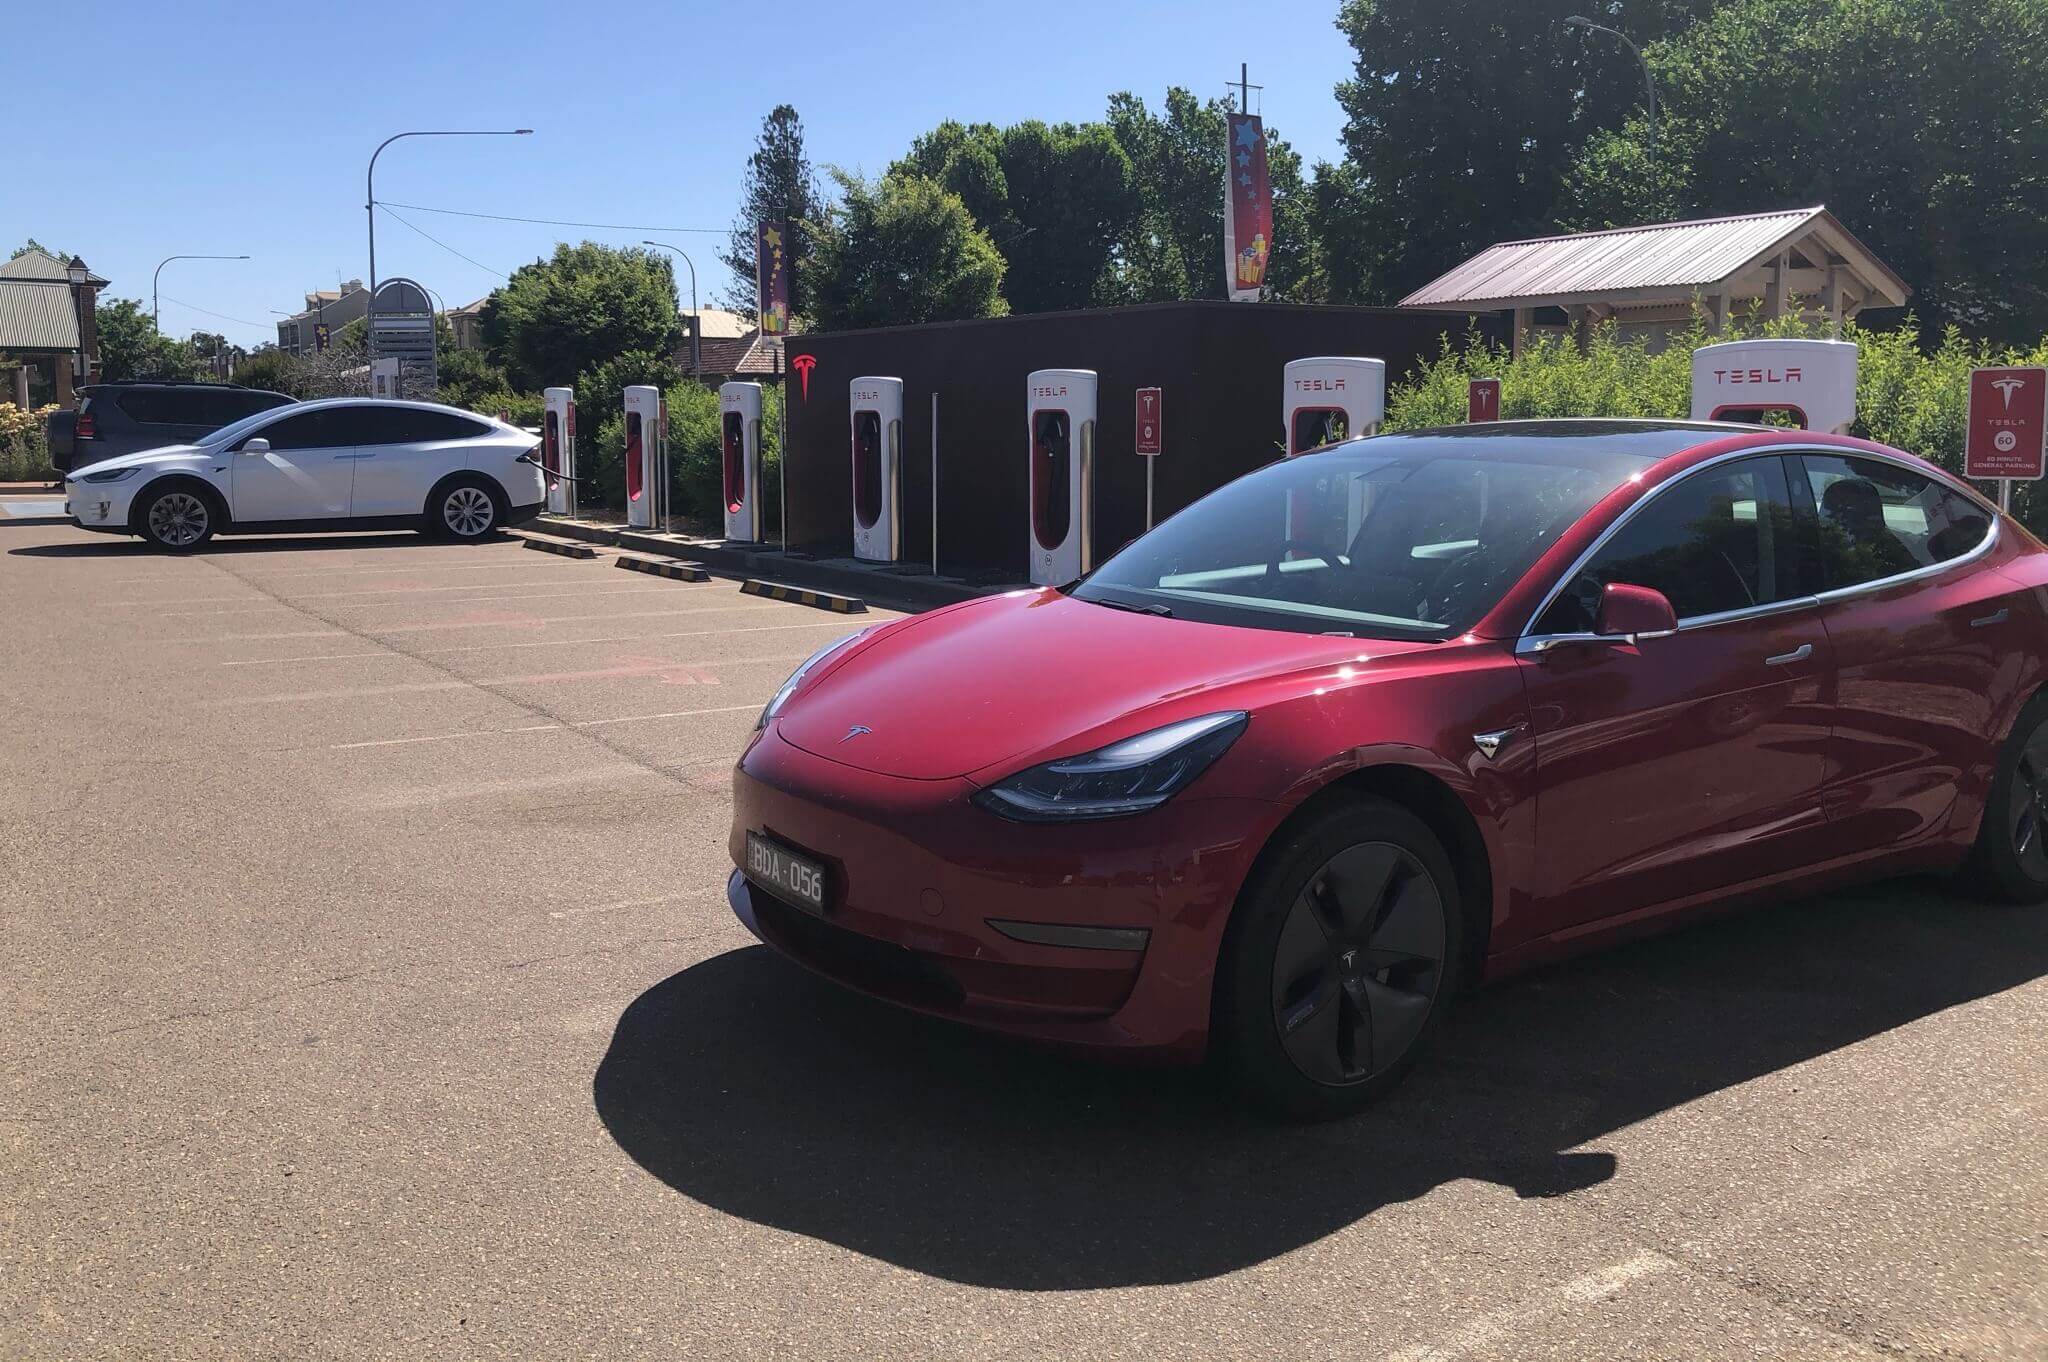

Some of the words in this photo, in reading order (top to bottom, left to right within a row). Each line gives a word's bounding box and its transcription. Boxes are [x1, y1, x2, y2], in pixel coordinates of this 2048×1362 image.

[1713, 368, 1801, 385] TESLA
[1294, 379, 1345, 391] TESLA
[853, 391, 879, 400] TESLA
[1033, 386, 1067, 397] TESLA
[1987, 418, 2025, 426] TESLA
[1998, 436, 2013, 445] 60
[790, 861, 822, 901] 056
